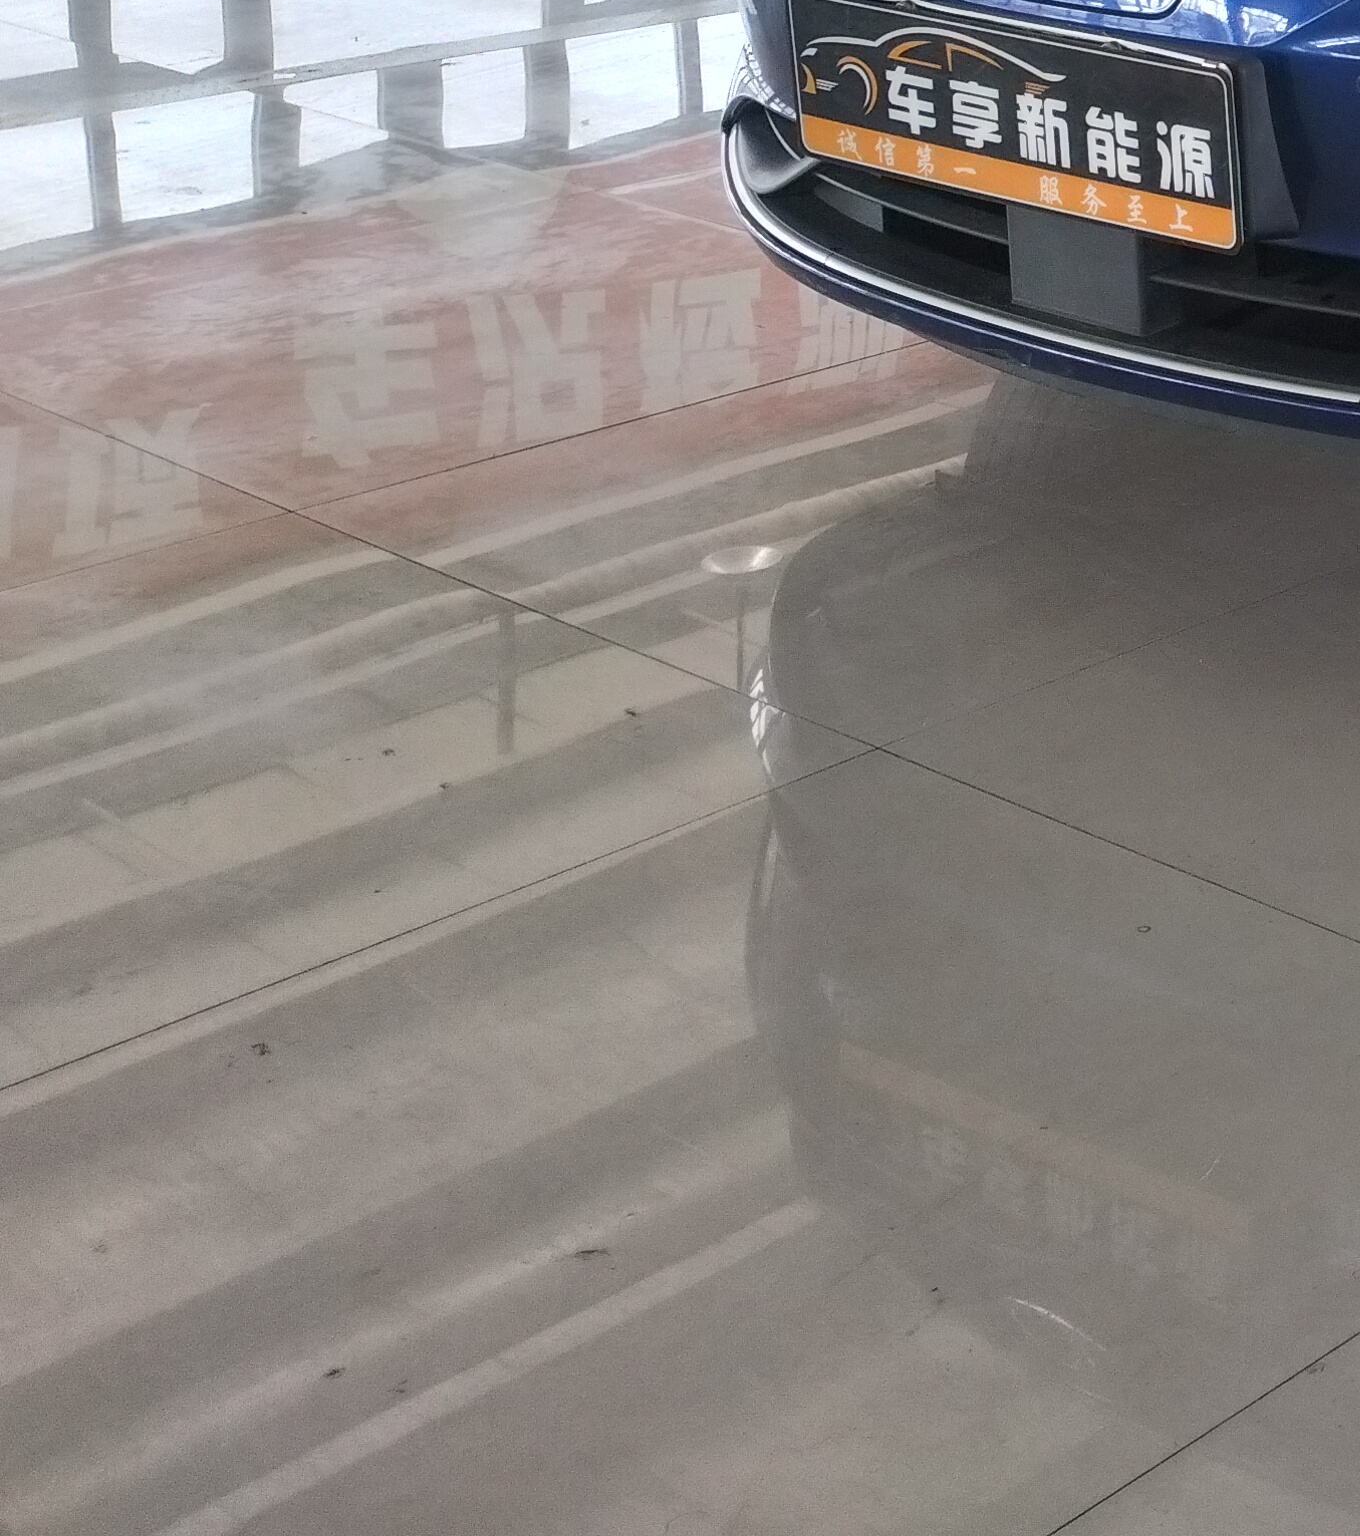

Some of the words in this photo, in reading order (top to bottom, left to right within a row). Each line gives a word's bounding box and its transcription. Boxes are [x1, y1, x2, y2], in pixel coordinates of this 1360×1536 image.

[835, 128, 978, 179] 诚信第一
[1038, 174, 1195, 234] 服务至上
[885, 65, 1216, 200] 车享新能源
